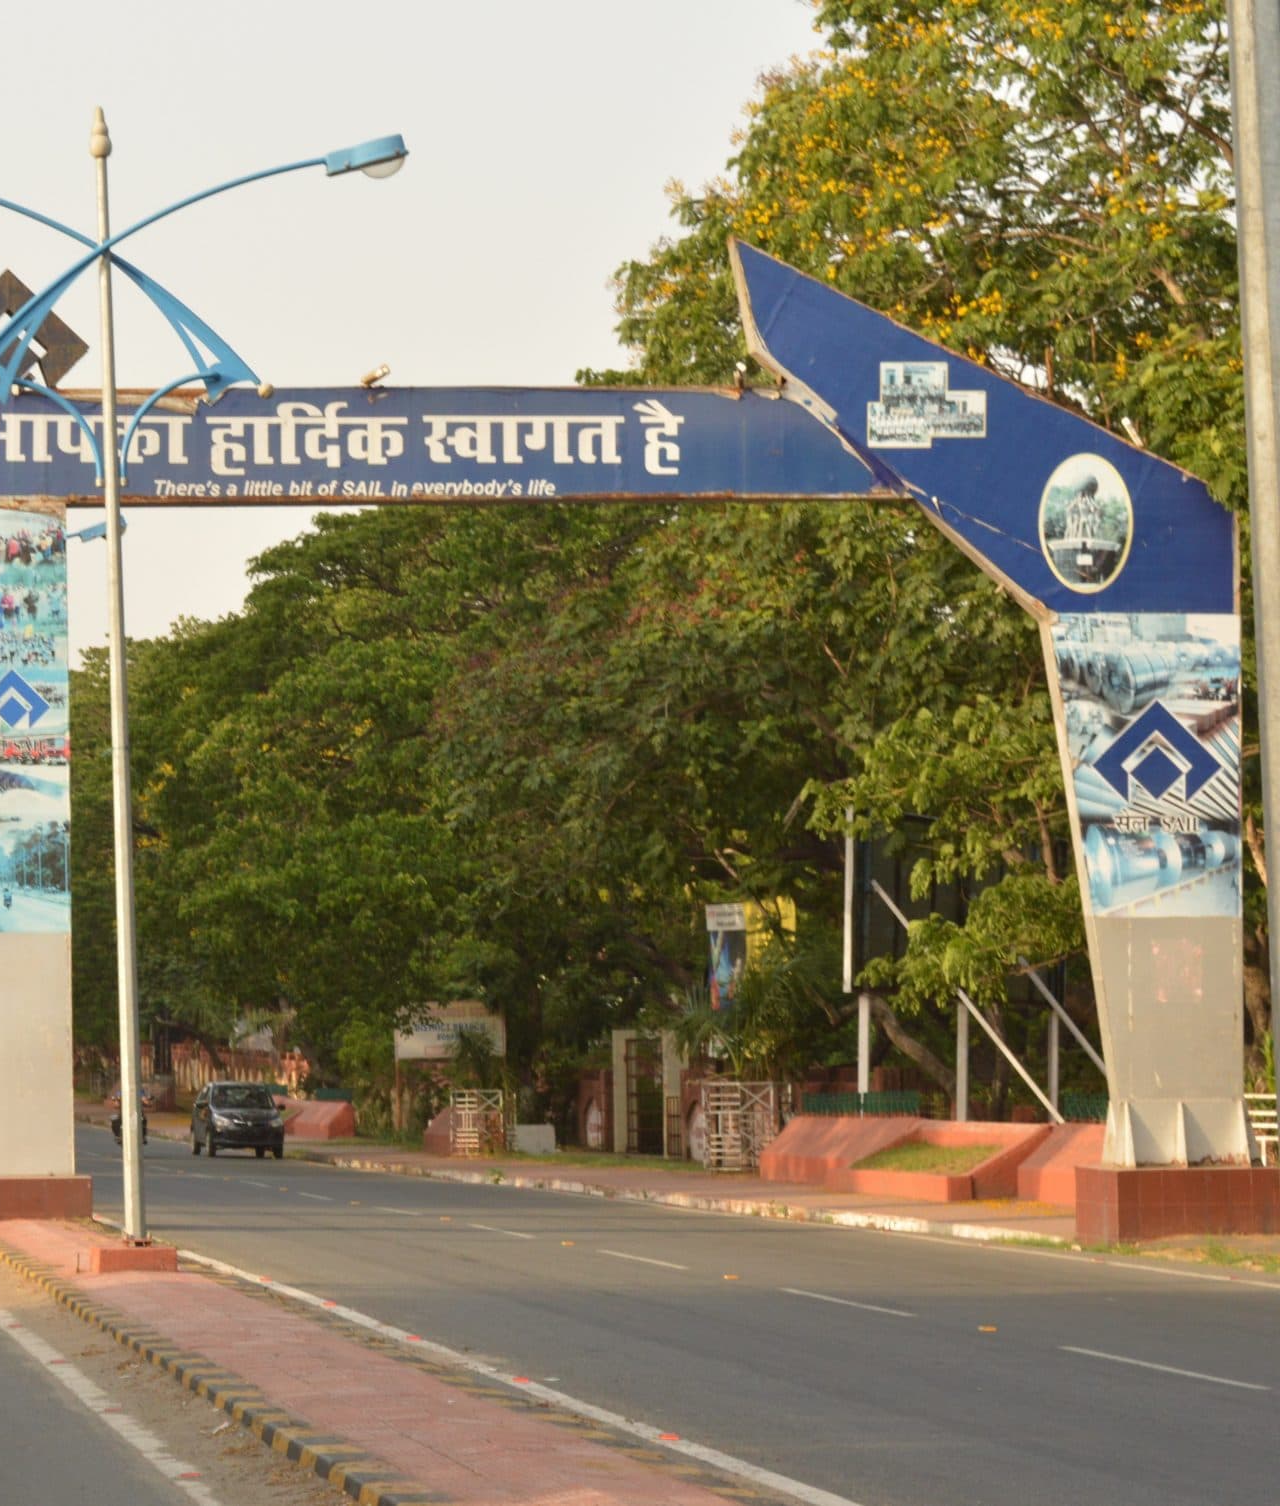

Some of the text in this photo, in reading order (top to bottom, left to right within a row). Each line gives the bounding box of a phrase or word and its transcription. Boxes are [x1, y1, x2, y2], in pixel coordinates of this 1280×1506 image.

[206, 402, 408, 476] हार्दिक
[422, 415, 625, 464] स्वागत
[632, 399, 685, 475] है
[154, 478, 556, 497] There's a little bit of SAIL in everybody's life
[1114, 809, 1149, 833] सेल
[1160, 815, 1200, 833] SAIL
